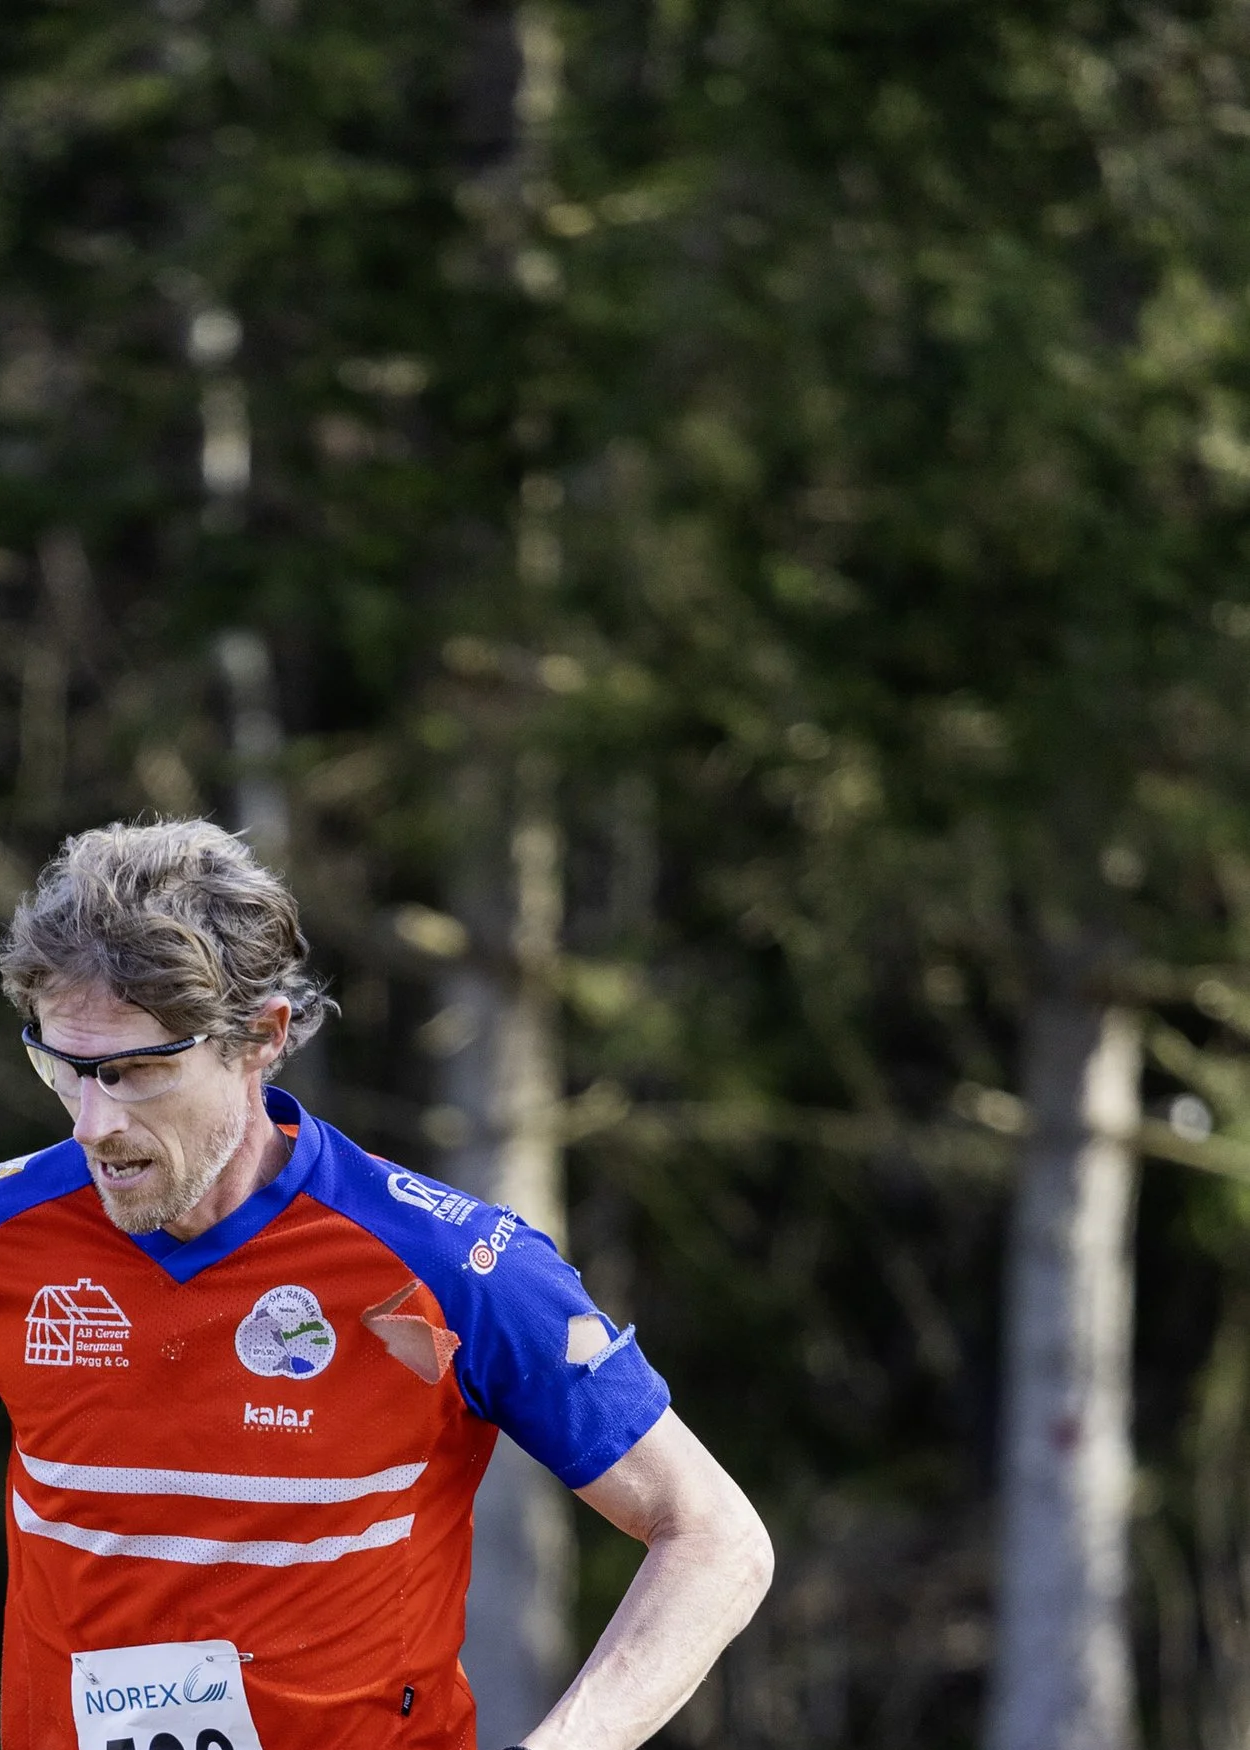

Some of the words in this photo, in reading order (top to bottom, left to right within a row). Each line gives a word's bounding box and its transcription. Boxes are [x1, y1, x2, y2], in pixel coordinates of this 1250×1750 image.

[269, 1293, 282, 1302] OK
[76, 1328, 92, 1337] AB
[76, 1341, 123, 1353] Bergman
[75, 1356, 102, 1367] Bygg
[104, 1356, 112, 1366] &
[115, 1357, 129, 1367] Co
[243, 1402, 314, 1427] kalas
[85, 1682, 182, 1715] NOREX
